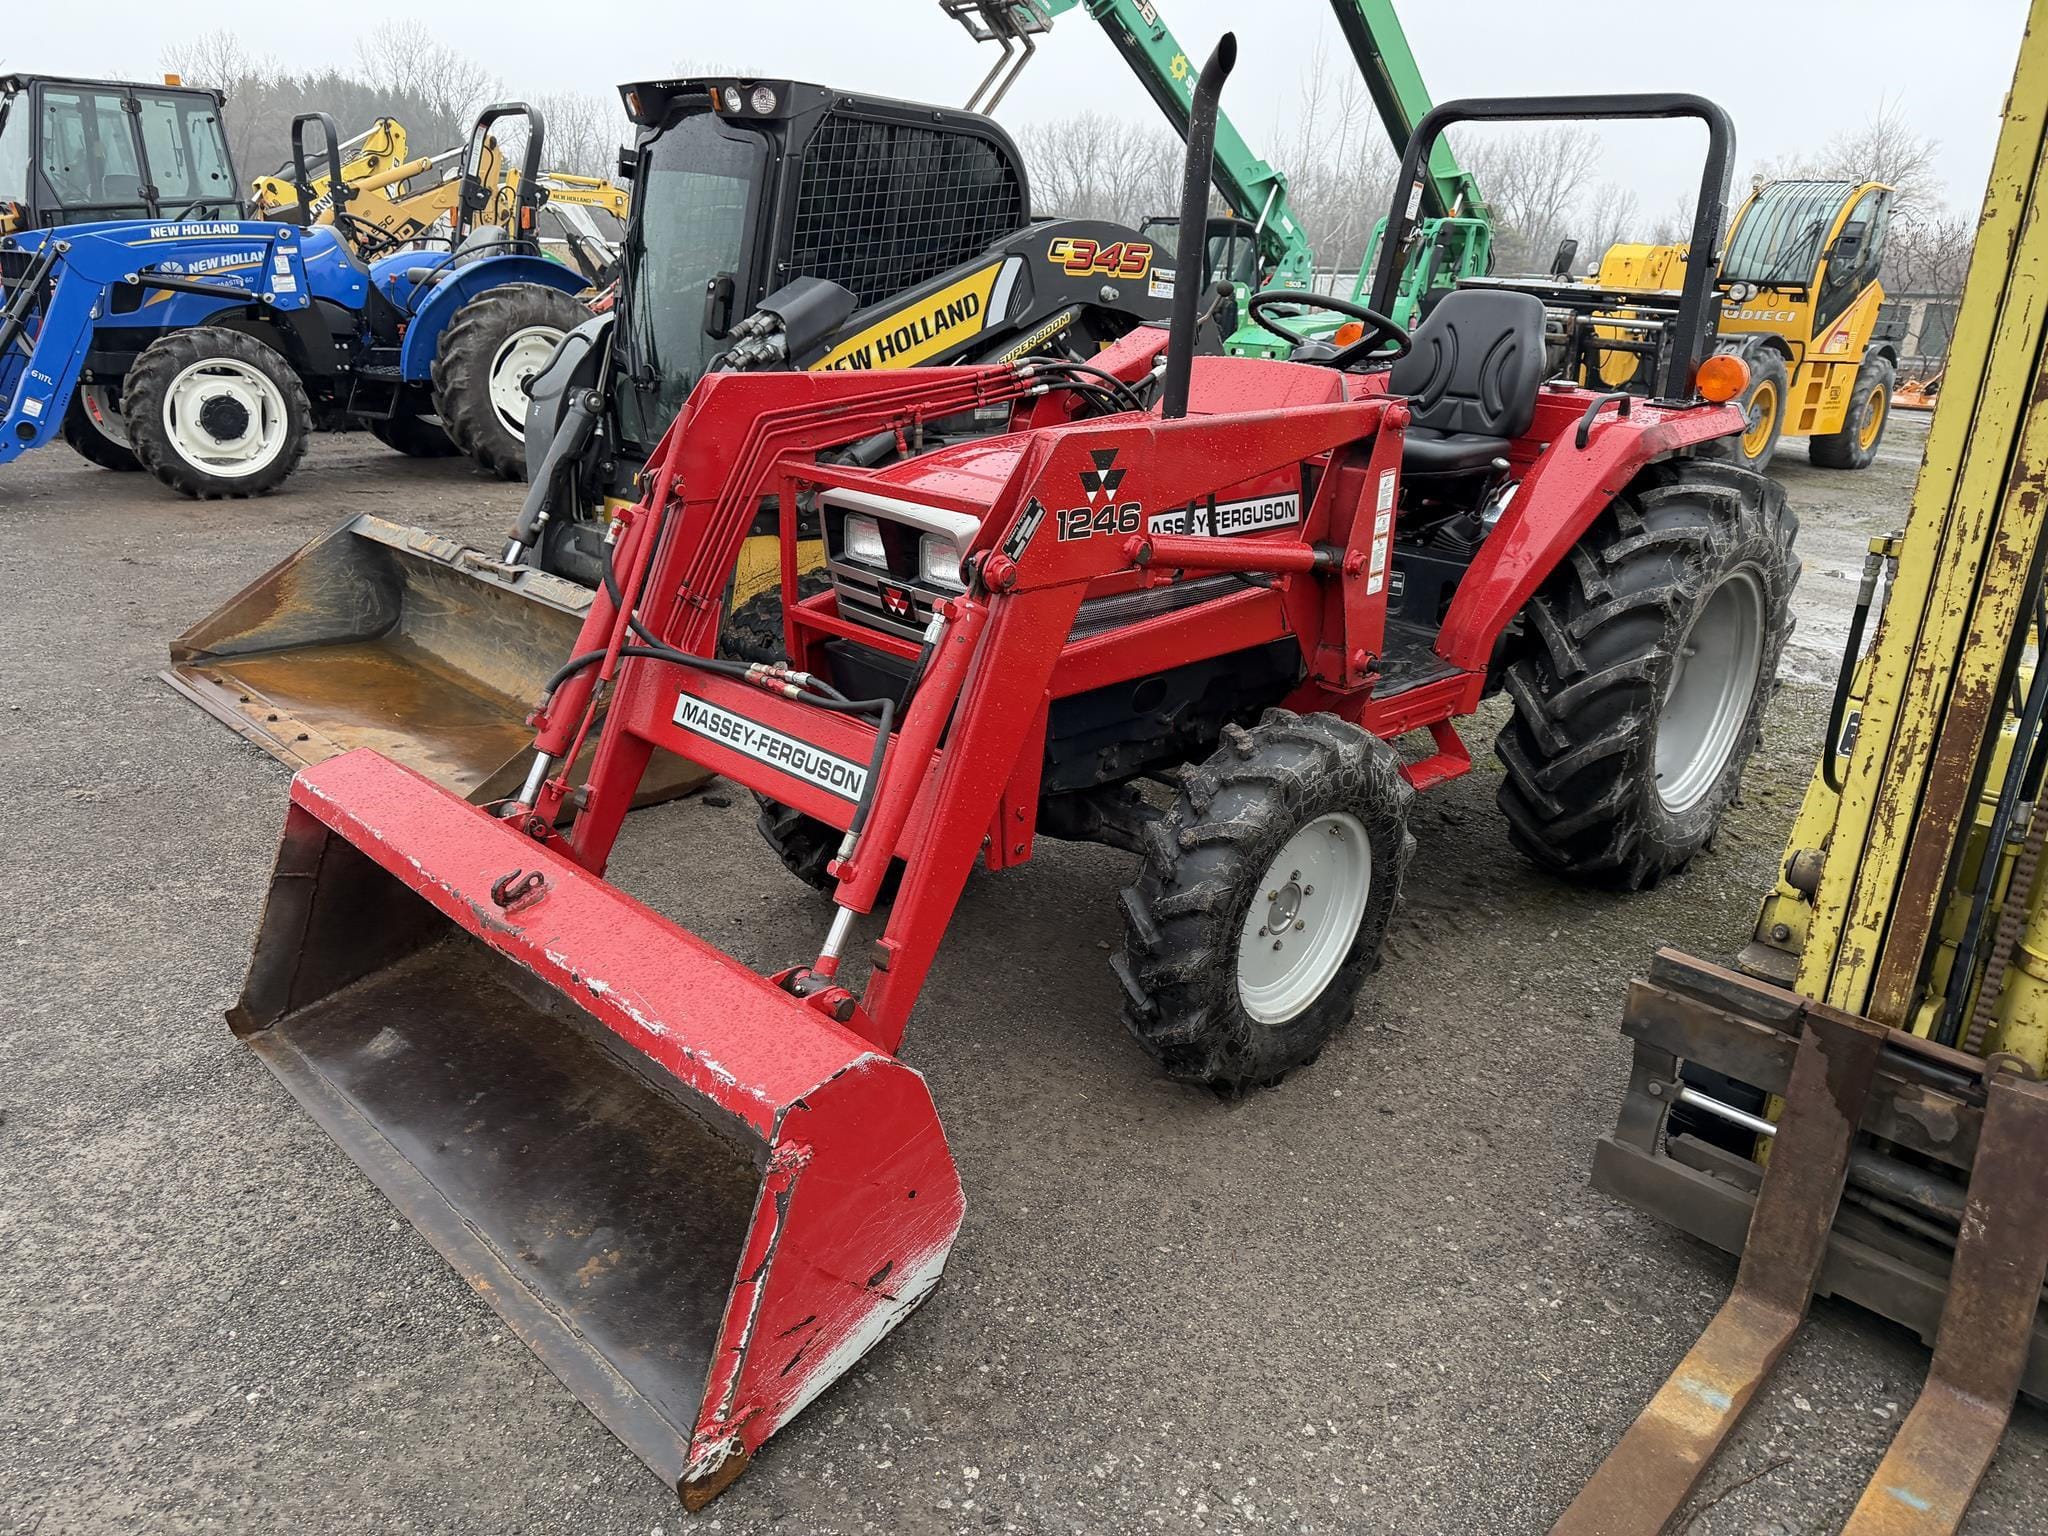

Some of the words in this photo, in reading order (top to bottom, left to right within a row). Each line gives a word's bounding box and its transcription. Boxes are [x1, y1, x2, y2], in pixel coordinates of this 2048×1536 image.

[150, 225, 179, 239] NEW
[182, 224, 239, 236] HOLLAND
[188, 257, 219, 274] NEW
[220, 250, 266, 267] HOLLAN
[1047, 237, 1153, 279] C345
[816, 344, 872, 371] EW
[875, 291, 980, 363] HOLLAND
[1740, 309, 1796, 322] DIECI
[997, 335, 1037, 365] SUPER
[1036, 311, 1071, 344] BOOM
[31, 369, 53, 386] 611TL
[1056, 501, 1142, 542] 1246
[682, 701, 862, 794] MASSEY-FERGUSON
